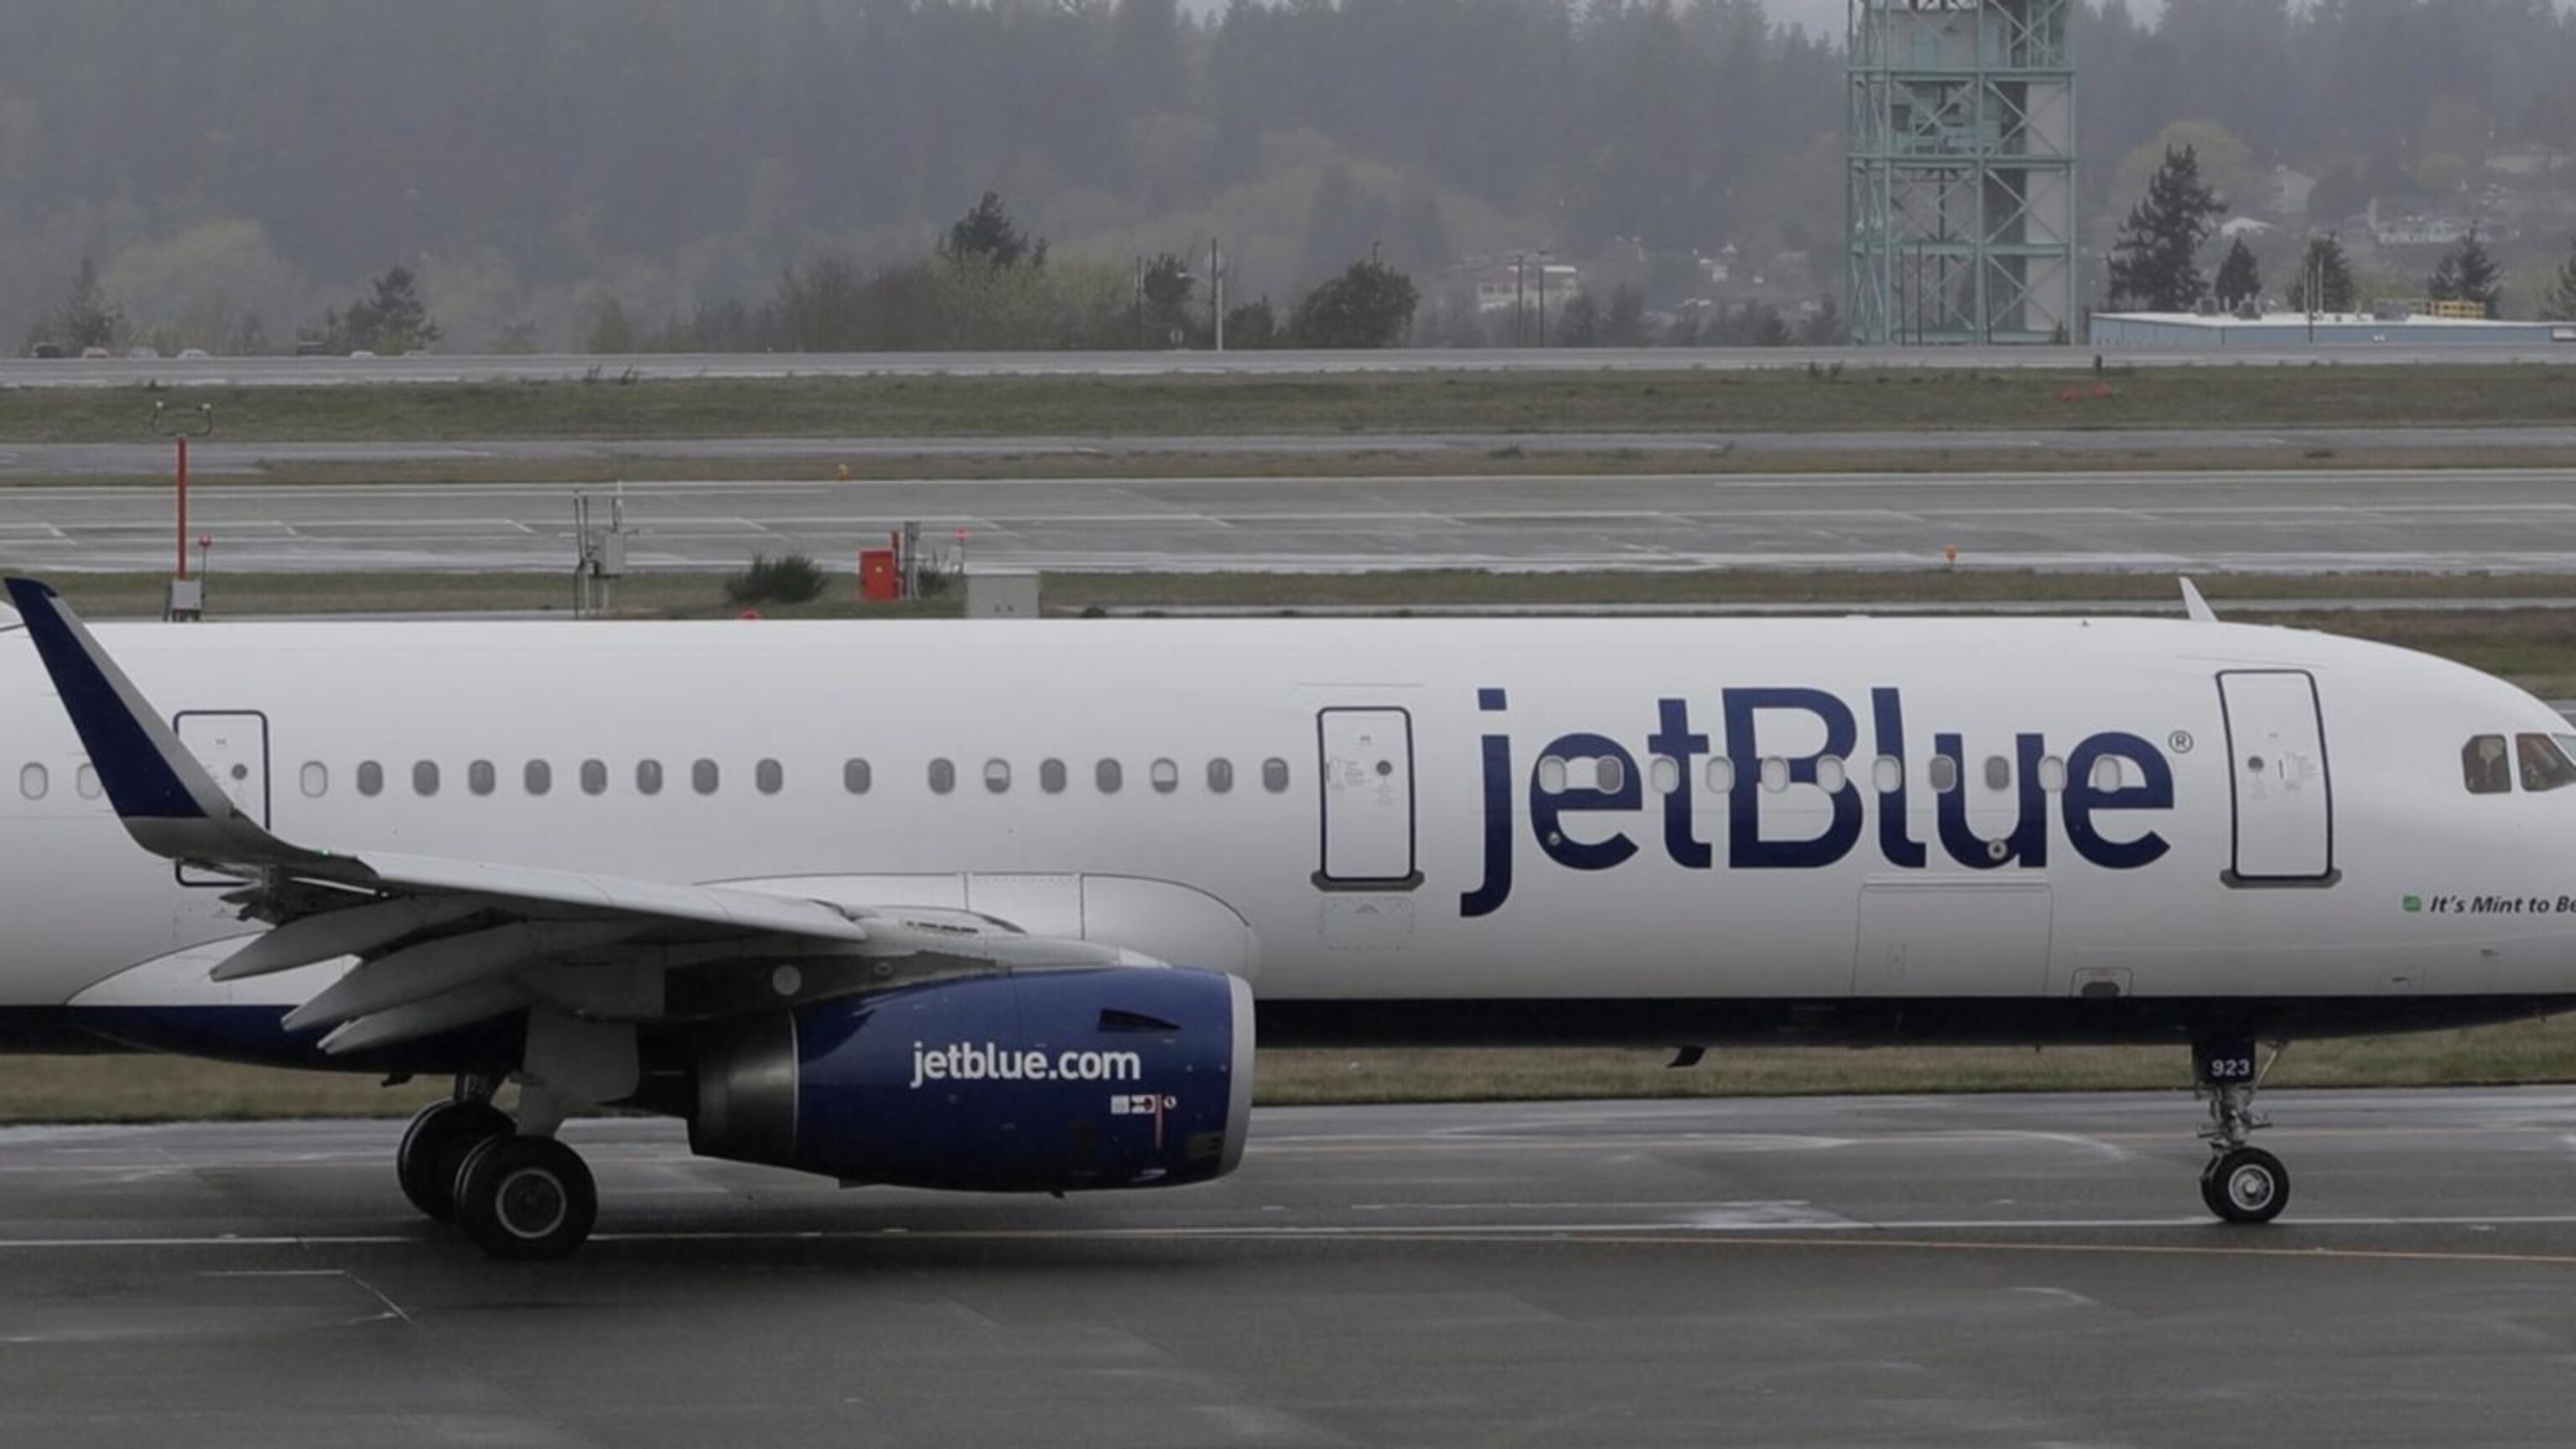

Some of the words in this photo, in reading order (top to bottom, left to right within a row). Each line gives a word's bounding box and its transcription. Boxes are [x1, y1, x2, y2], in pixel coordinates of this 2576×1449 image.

[1460, 687, 2174, 917] jetBlue
[2471, 896, 2523, 914] Mint
[2528, 897, 2551, 914] to
[910, 1041, 1141, 1088] jetblue.com
[2211, 1059, 2250, 1076] 923
